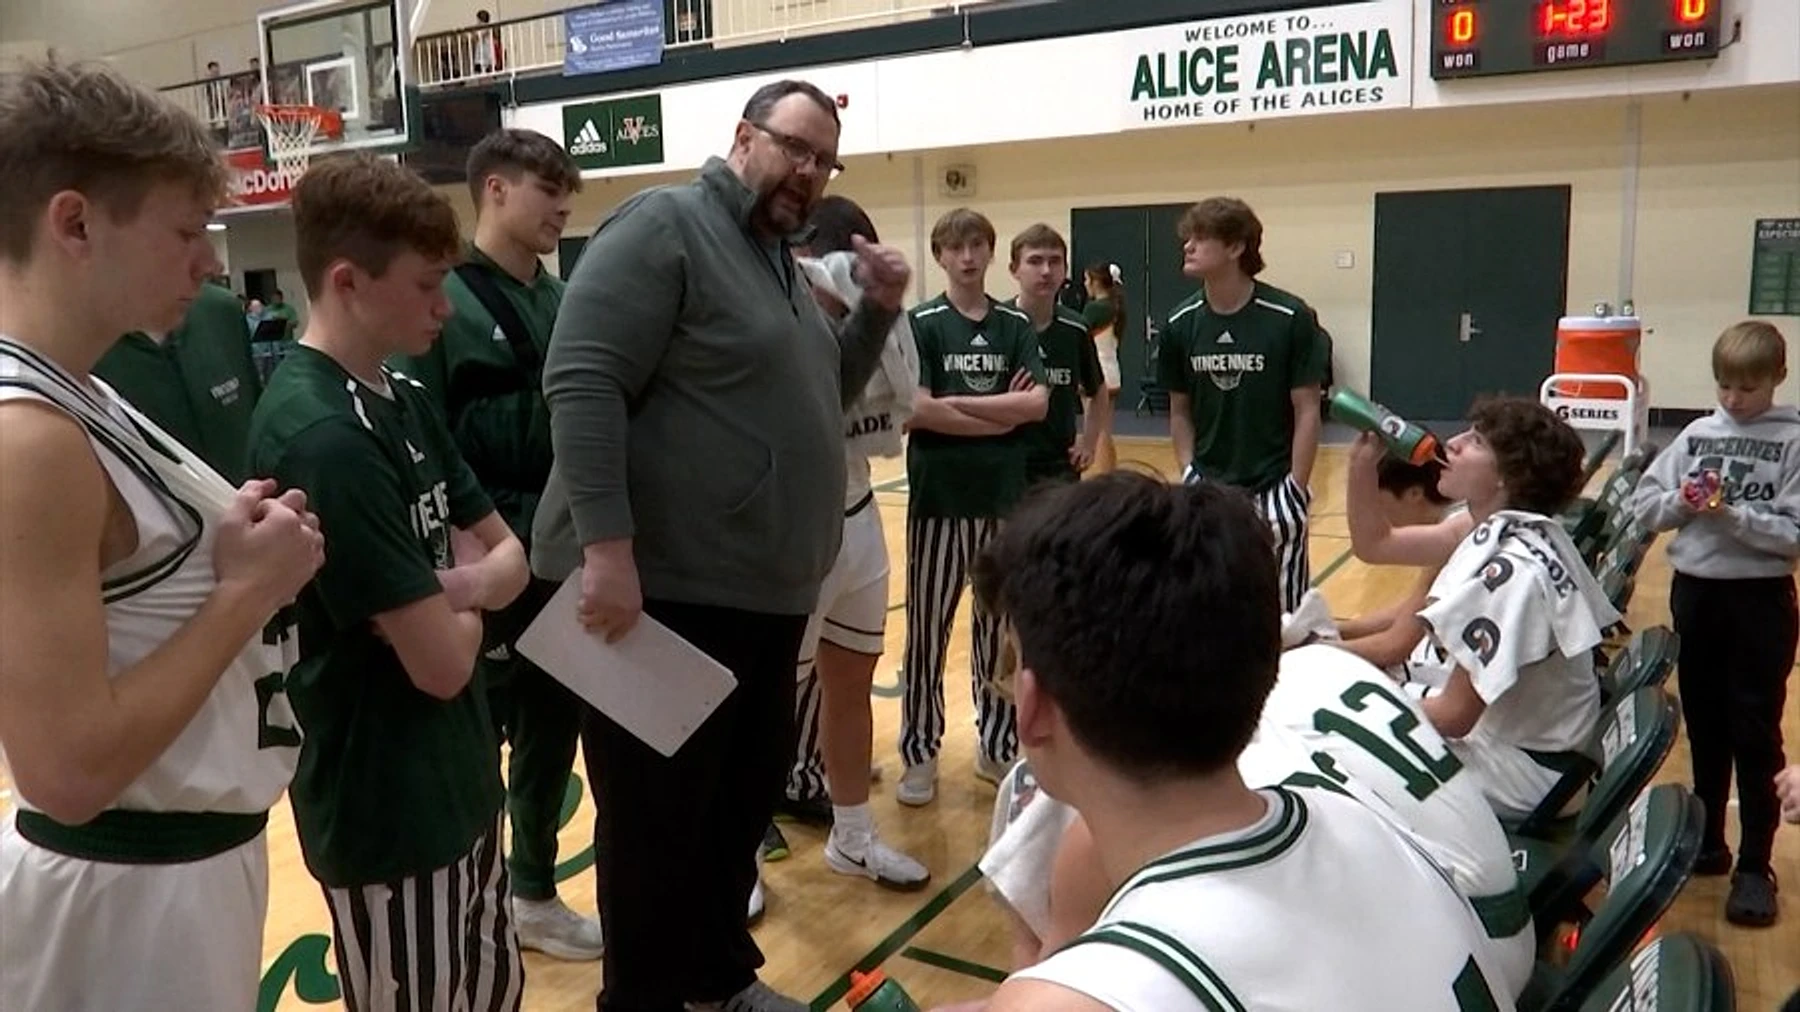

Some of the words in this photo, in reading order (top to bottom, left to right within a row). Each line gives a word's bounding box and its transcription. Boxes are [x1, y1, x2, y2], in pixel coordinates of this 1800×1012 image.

[1186, 19, 1276, 43] WELCOME
[1453, 11, 1473, 41] 0
[1670, 31, 1705, 49] won
[1131, 45, 1239, 100] ALICE
[1256, 28, 1398, 89] ARENA
[1444, 53, 1473, 68] won
[1548, 43, 1589, 63] game
[1144, 101, 1203, 120] HOME
[1214, 98, 1240, 115] OF
[1251, 94, 1291, 112] THE
[1301, 86, 1384, 107] ALICES
[570, 140, 608, 156] adidas
[1189, 353, 1265, 372] VINCENNES
[1571, 407, 1619, 419] SERIES
[1687, 436, 1784, 463] VINCENNES
[1312, 680, 1464, 802] 12
